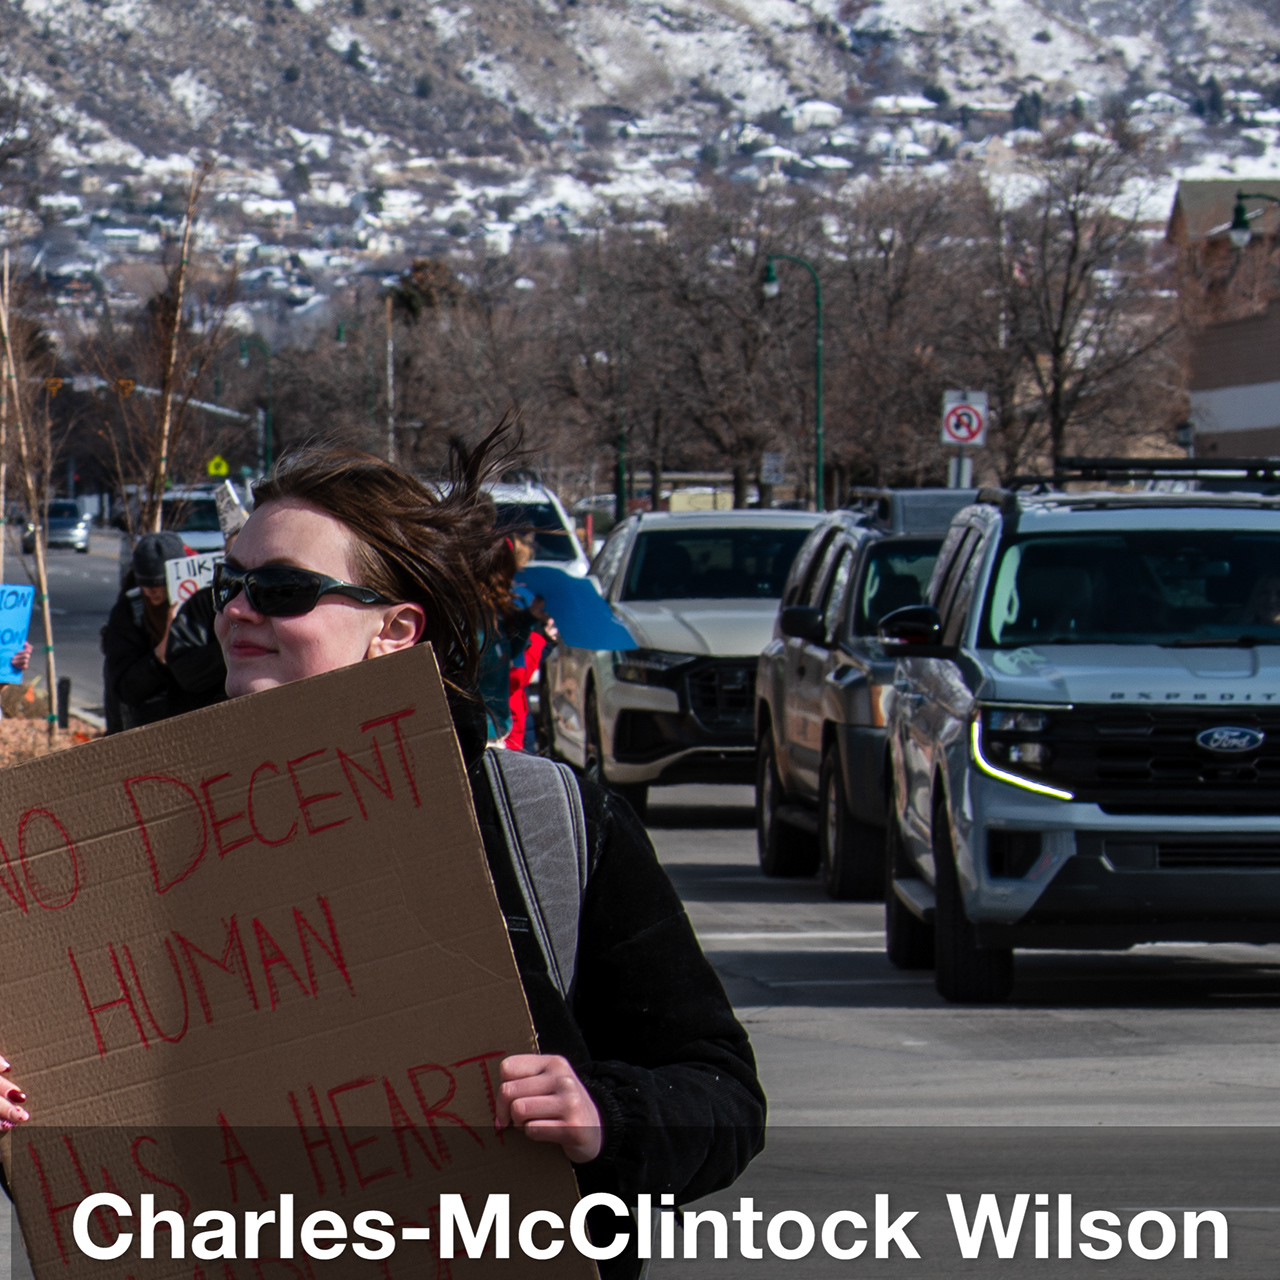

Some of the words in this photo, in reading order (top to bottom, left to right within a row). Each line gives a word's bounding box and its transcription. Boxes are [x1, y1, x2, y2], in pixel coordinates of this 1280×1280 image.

[125, 708, 422, 893] DECENT
[67, 893, 357, 1057] HUMAN
[220, 1108, 269, 1204] A
